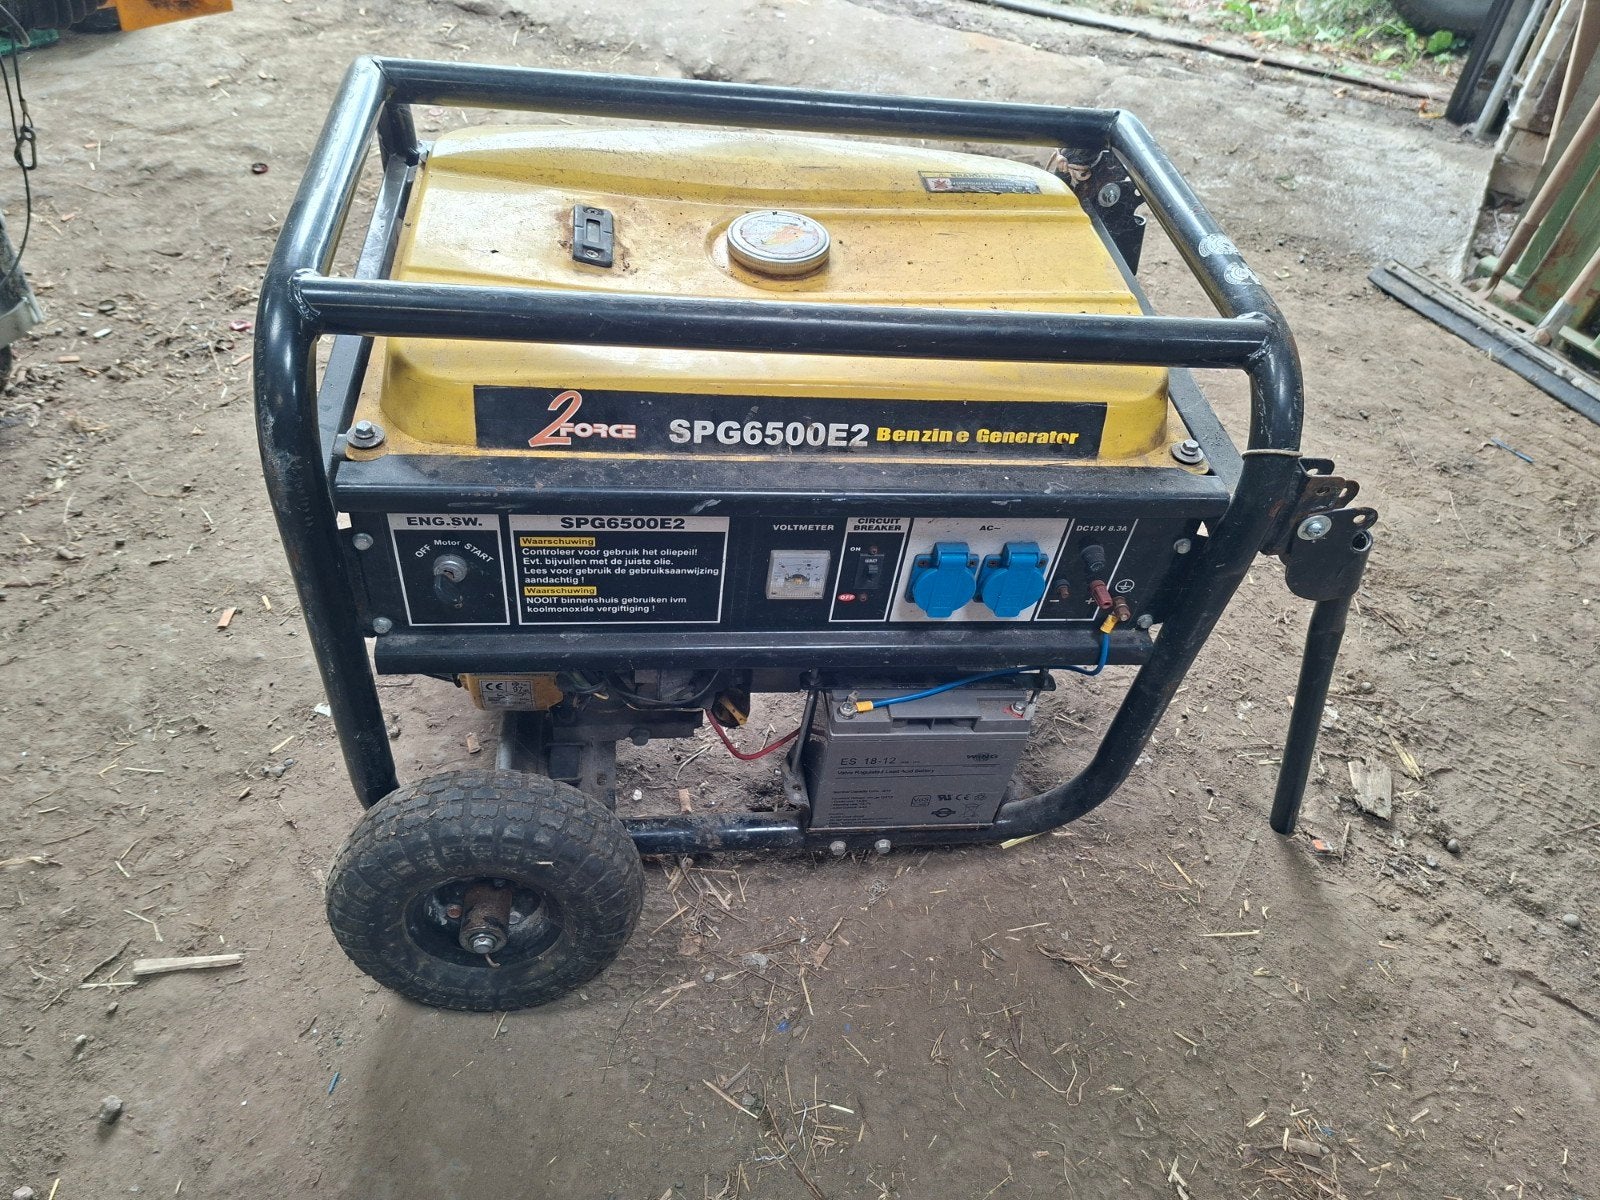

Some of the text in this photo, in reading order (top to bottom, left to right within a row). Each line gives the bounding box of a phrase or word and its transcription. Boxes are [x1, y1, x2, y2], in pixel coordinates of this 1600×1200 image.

[669, 419, 869, 447] SPG6500E2
[976, 428, 1079, 445] Generator
[406, 516, 482, 526] ENG.SW.
[560, 517, 686, 530] SPG6500E2
[522, 538, 594, 546] Waarschuwing
[415, 544, 431, 558] OFF
[464, 543, 494, 562] START
[522, 548, 575, 556] Controleer
[603, 549, 640, 557] gebruik
[545, 558, 587, 566] bijvullen
[624, 558, 652, 566] juiste
[524, 567, 548, 575] Lees
[575, 567, 612, 576] gebruik
[614, 567, 626, 575] de
[629, 567, 719, 576] gebruiksaanwijzing
[524, 576, 579, 585] aandachtig
[526, 587, 596, 595] Waarschuwing
[621, 597, 668, 605] gebruiken
[527, 605, 594, 613] koolmonoxide
[597, 605, 649, 614] vergiftiging
[840, 758, 857, 766] ES
[865, 757, 896, 765] 18-12
